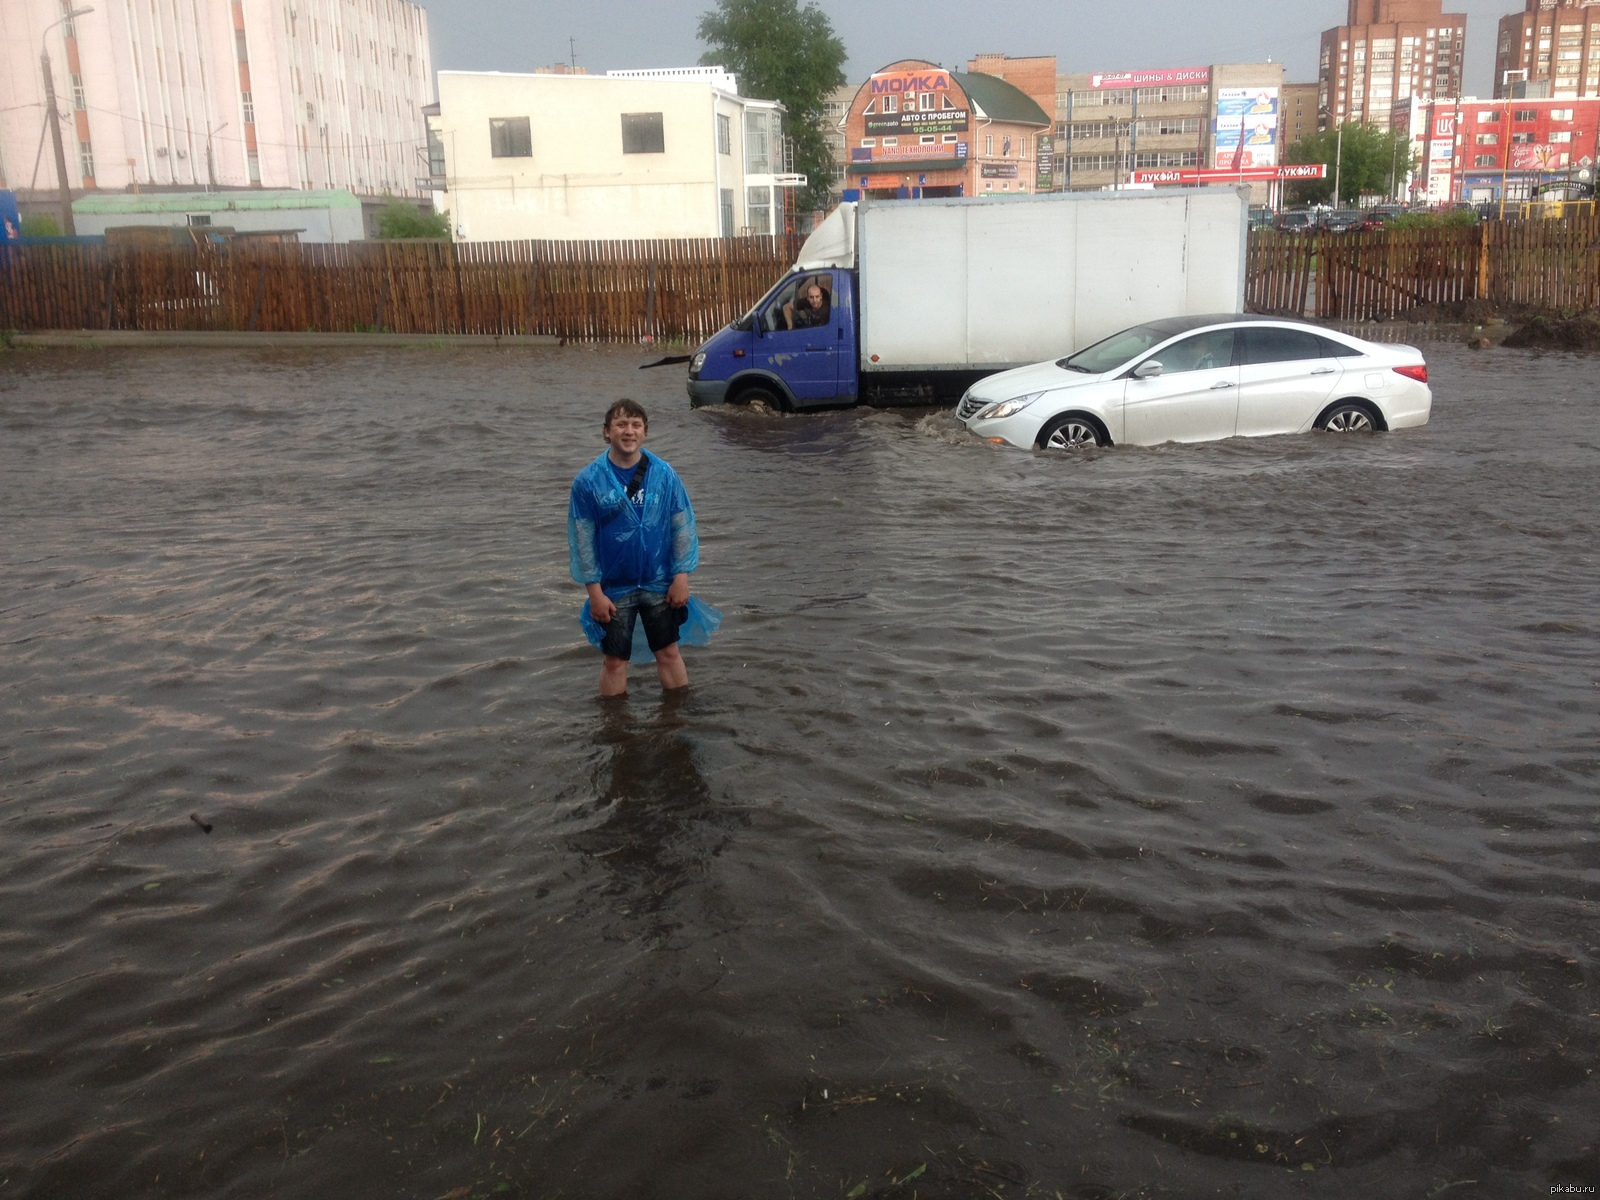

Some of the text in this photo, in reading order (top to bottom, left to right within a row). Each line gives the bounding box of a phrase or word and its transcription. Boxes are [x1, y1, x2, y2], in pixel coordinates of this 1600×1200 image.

[871, 72, 948, 93] МОЙКА
[1133, 74, 1164, 83] ШИНЫ
[1166, 72, 1173, 80] &
[1175, 71, 1208, 81] ДИСКИ
[901, 111, 966, 122] АВТО С ПРОБЕГОМ
[913, 125, 952, 133] 95-05-44
[882, 144, 945, 156] NANO ТЕХНОЛОГИИ
[1140, 171, 1181, 182] ЛУКОЙЛ
[1277, 166, 1318, 178] ЛУКОЙЛ
